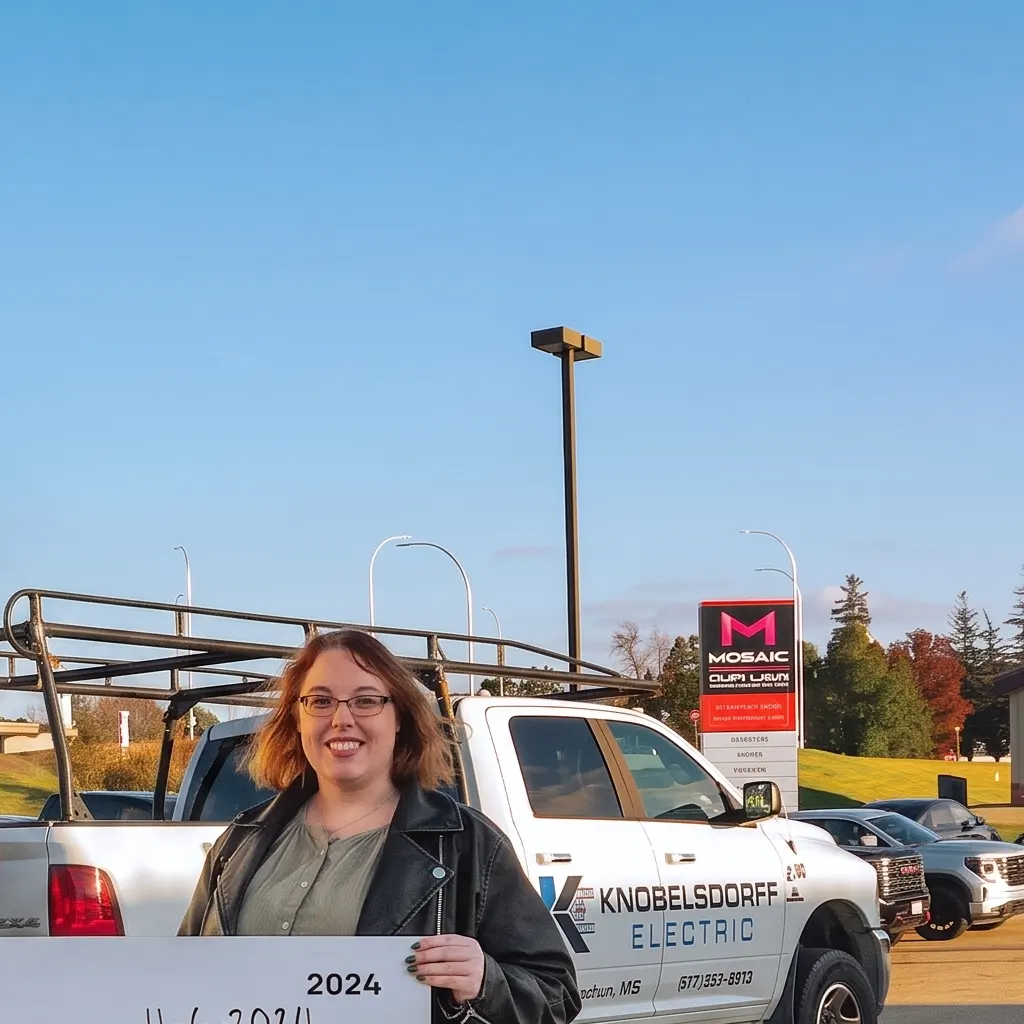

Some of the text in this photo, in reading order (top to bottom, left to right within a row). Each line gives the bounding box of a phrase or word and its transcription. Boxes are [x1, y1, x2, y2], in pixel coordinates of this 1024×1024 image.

[708, 650, 789, 664] MOSAIC
[600, 882, 778, 914] KNOBELSDORFF
[632, 918, 754, 949] ELECTRIC
[307, 973, 382, 995] 2024
[619, 979, 642, 996] MS
